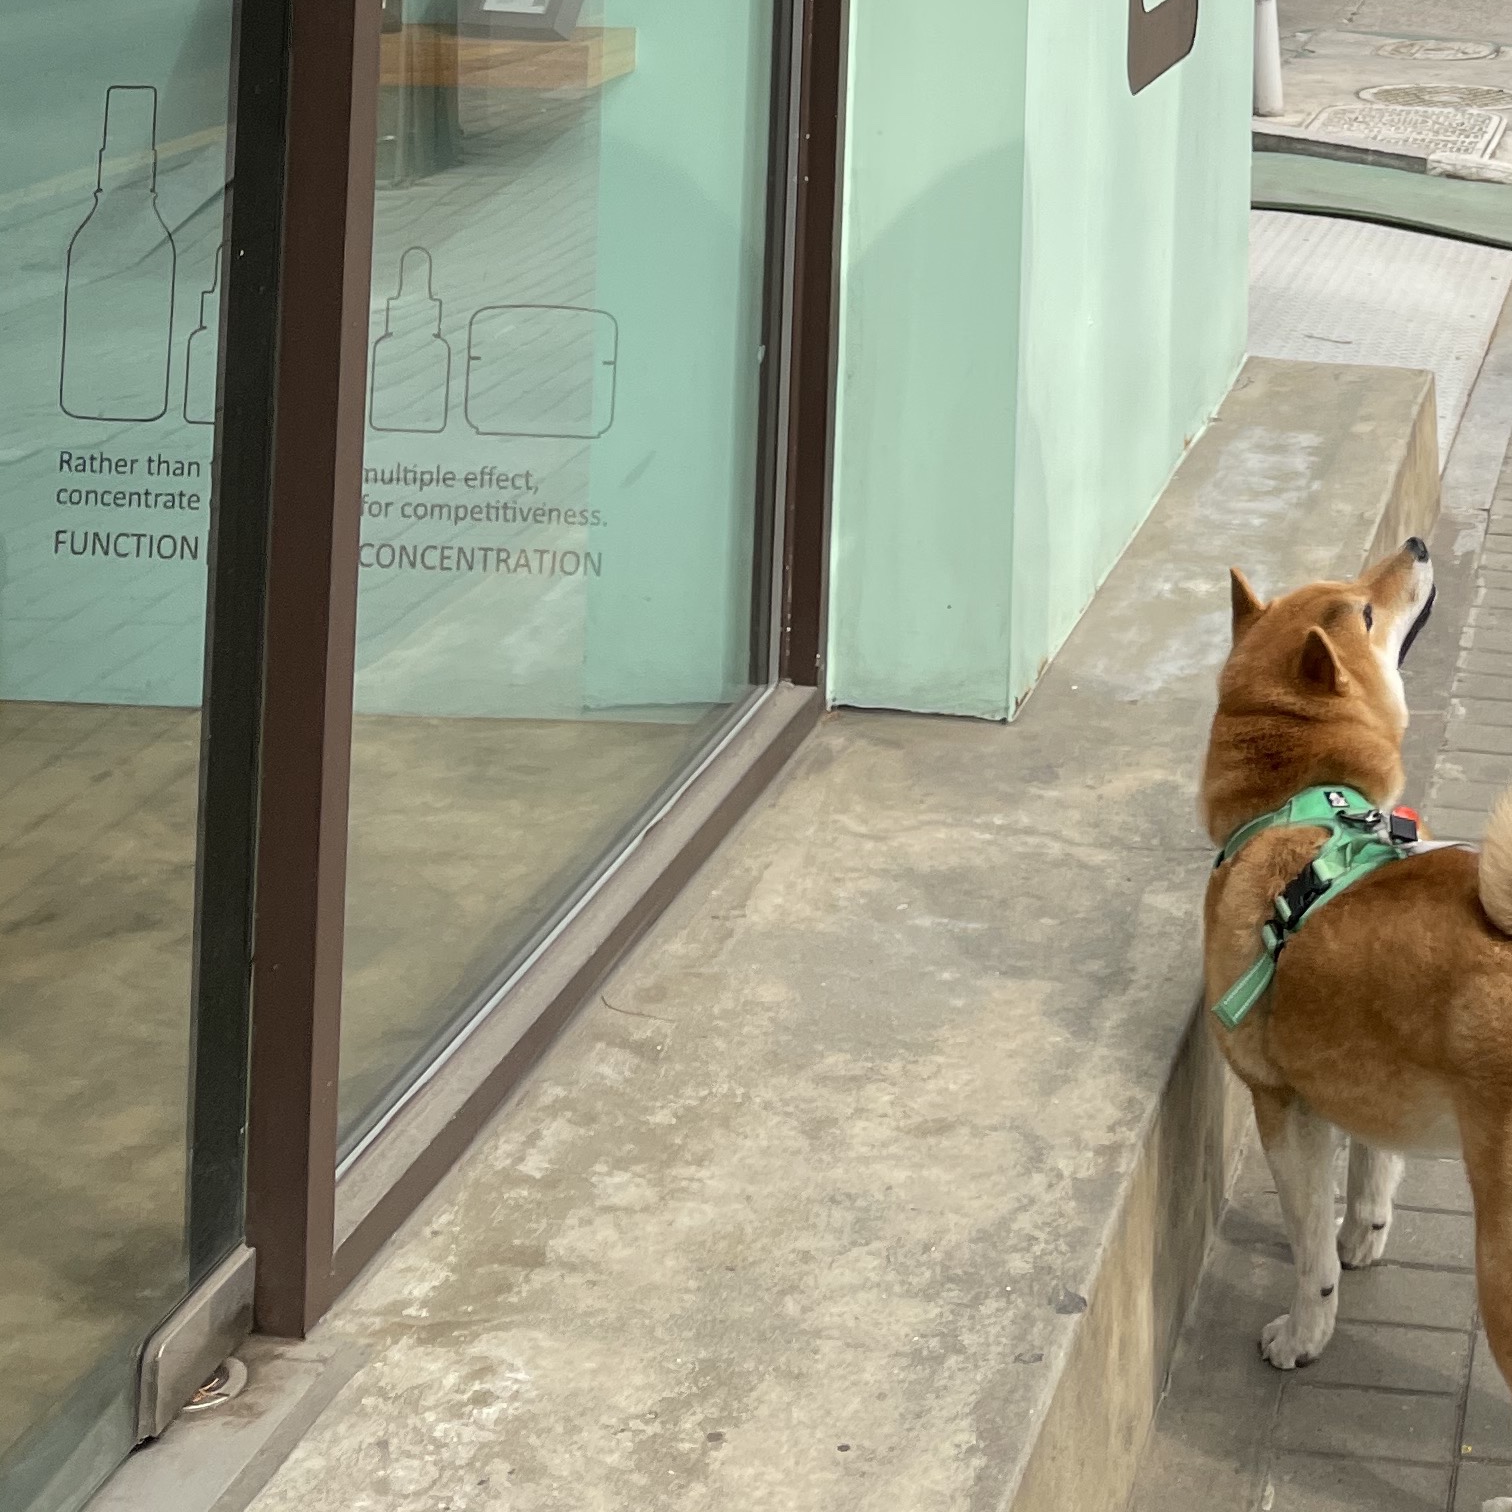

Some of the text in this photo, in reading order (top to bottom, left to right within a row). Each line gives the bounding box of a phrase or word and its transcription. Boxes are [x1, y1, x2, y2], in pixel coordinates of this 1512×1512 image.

[59, 450, 139, 476] Rather
[146, 453, 200, 478] than
[463, 465, 539, 495] effect,
[56, 487, 201, 511] concentrate
[400, 500, 608, 527] competitiveness.
[54, 529, 603, 578] FUNCTION CONCENTRATION
